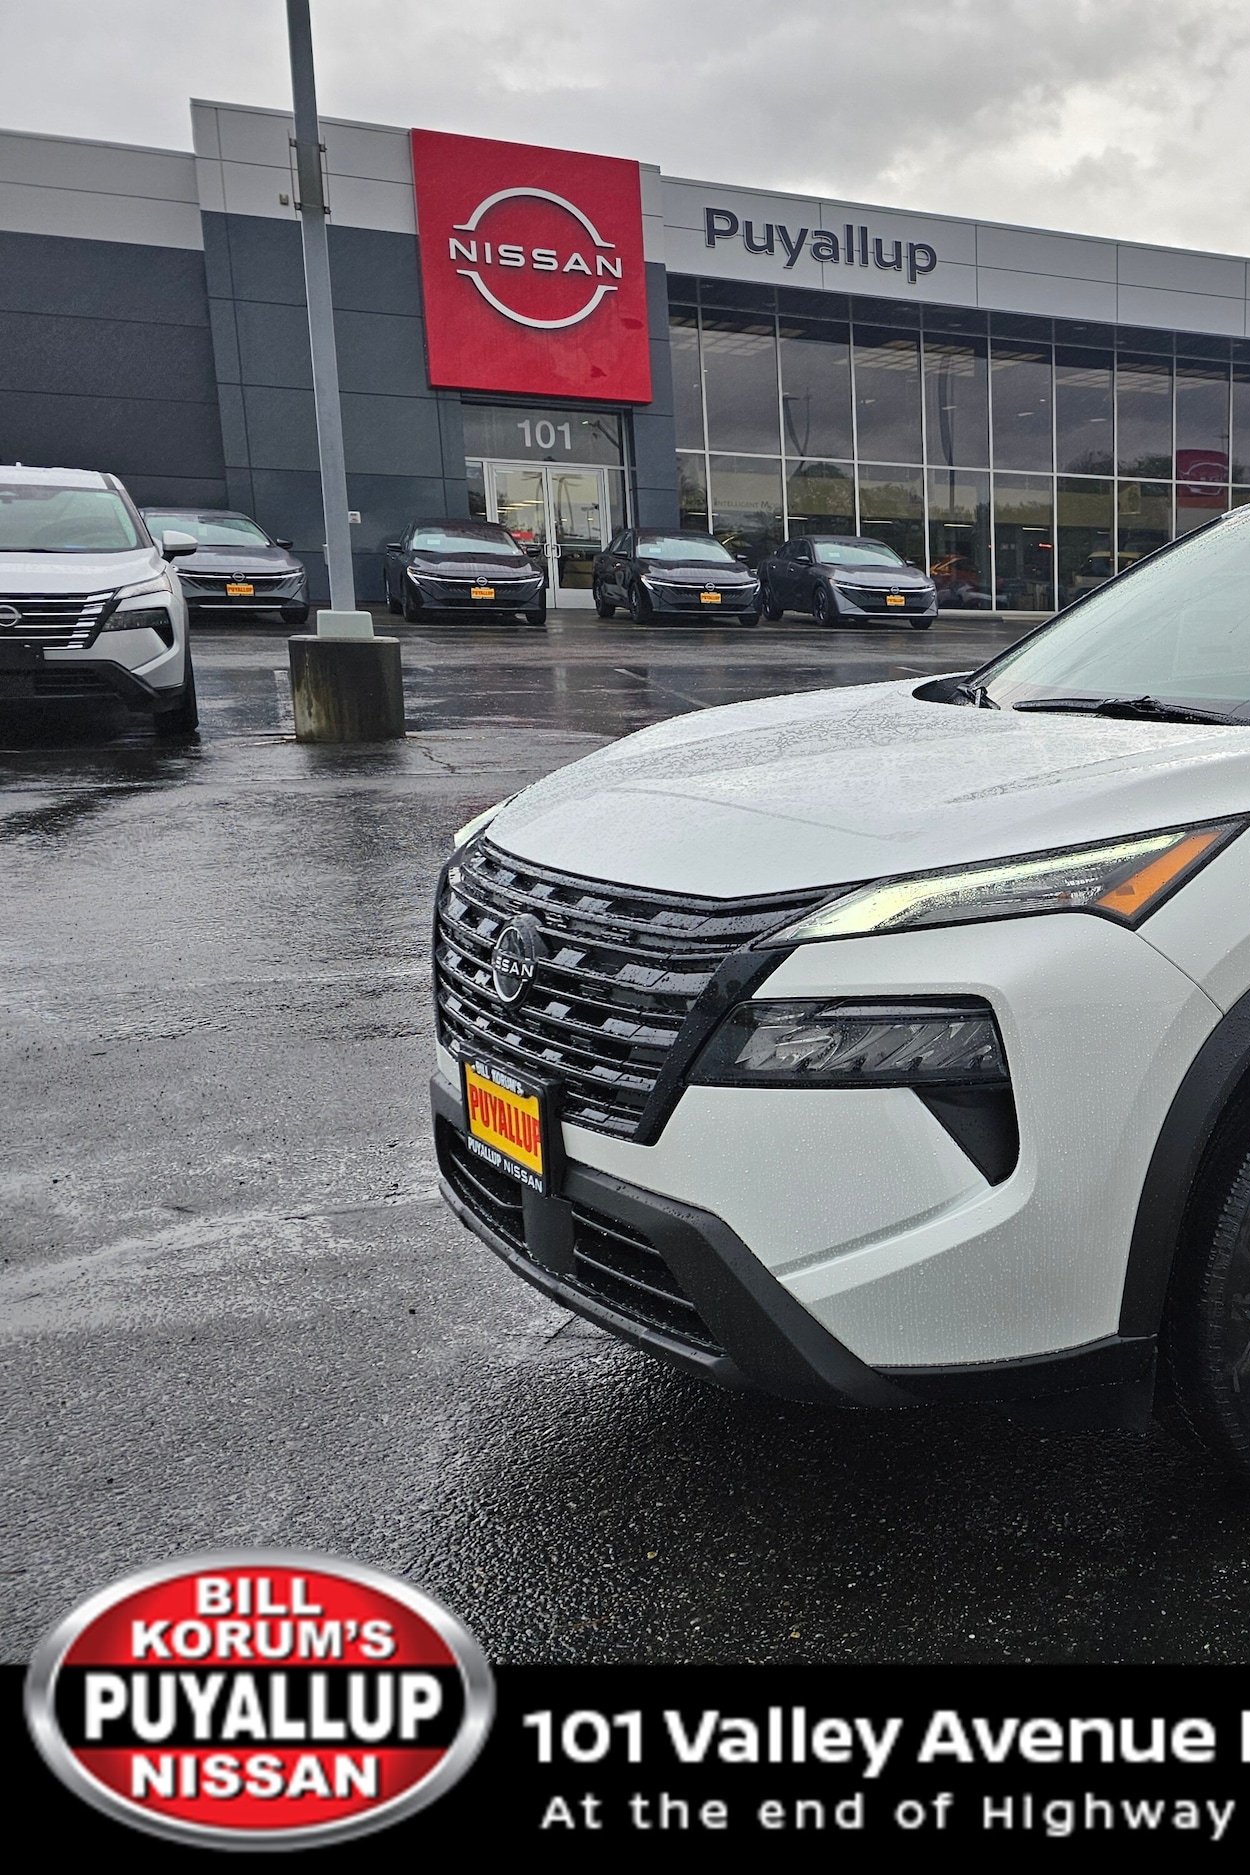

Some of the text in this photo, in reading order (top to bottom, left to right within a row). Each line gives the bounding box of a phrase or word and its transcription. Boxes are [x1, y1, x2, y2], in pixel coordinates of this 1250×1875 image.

[448, 237, 623, 279] NISSAN
[703, 206, 938, 284] Puyallup
[517, 419, 572, 450] 101
[468, 1083, 541, 1157] PUYALLUP
[467, 1136, 543, 1193] PUYALLUP NISSAN
